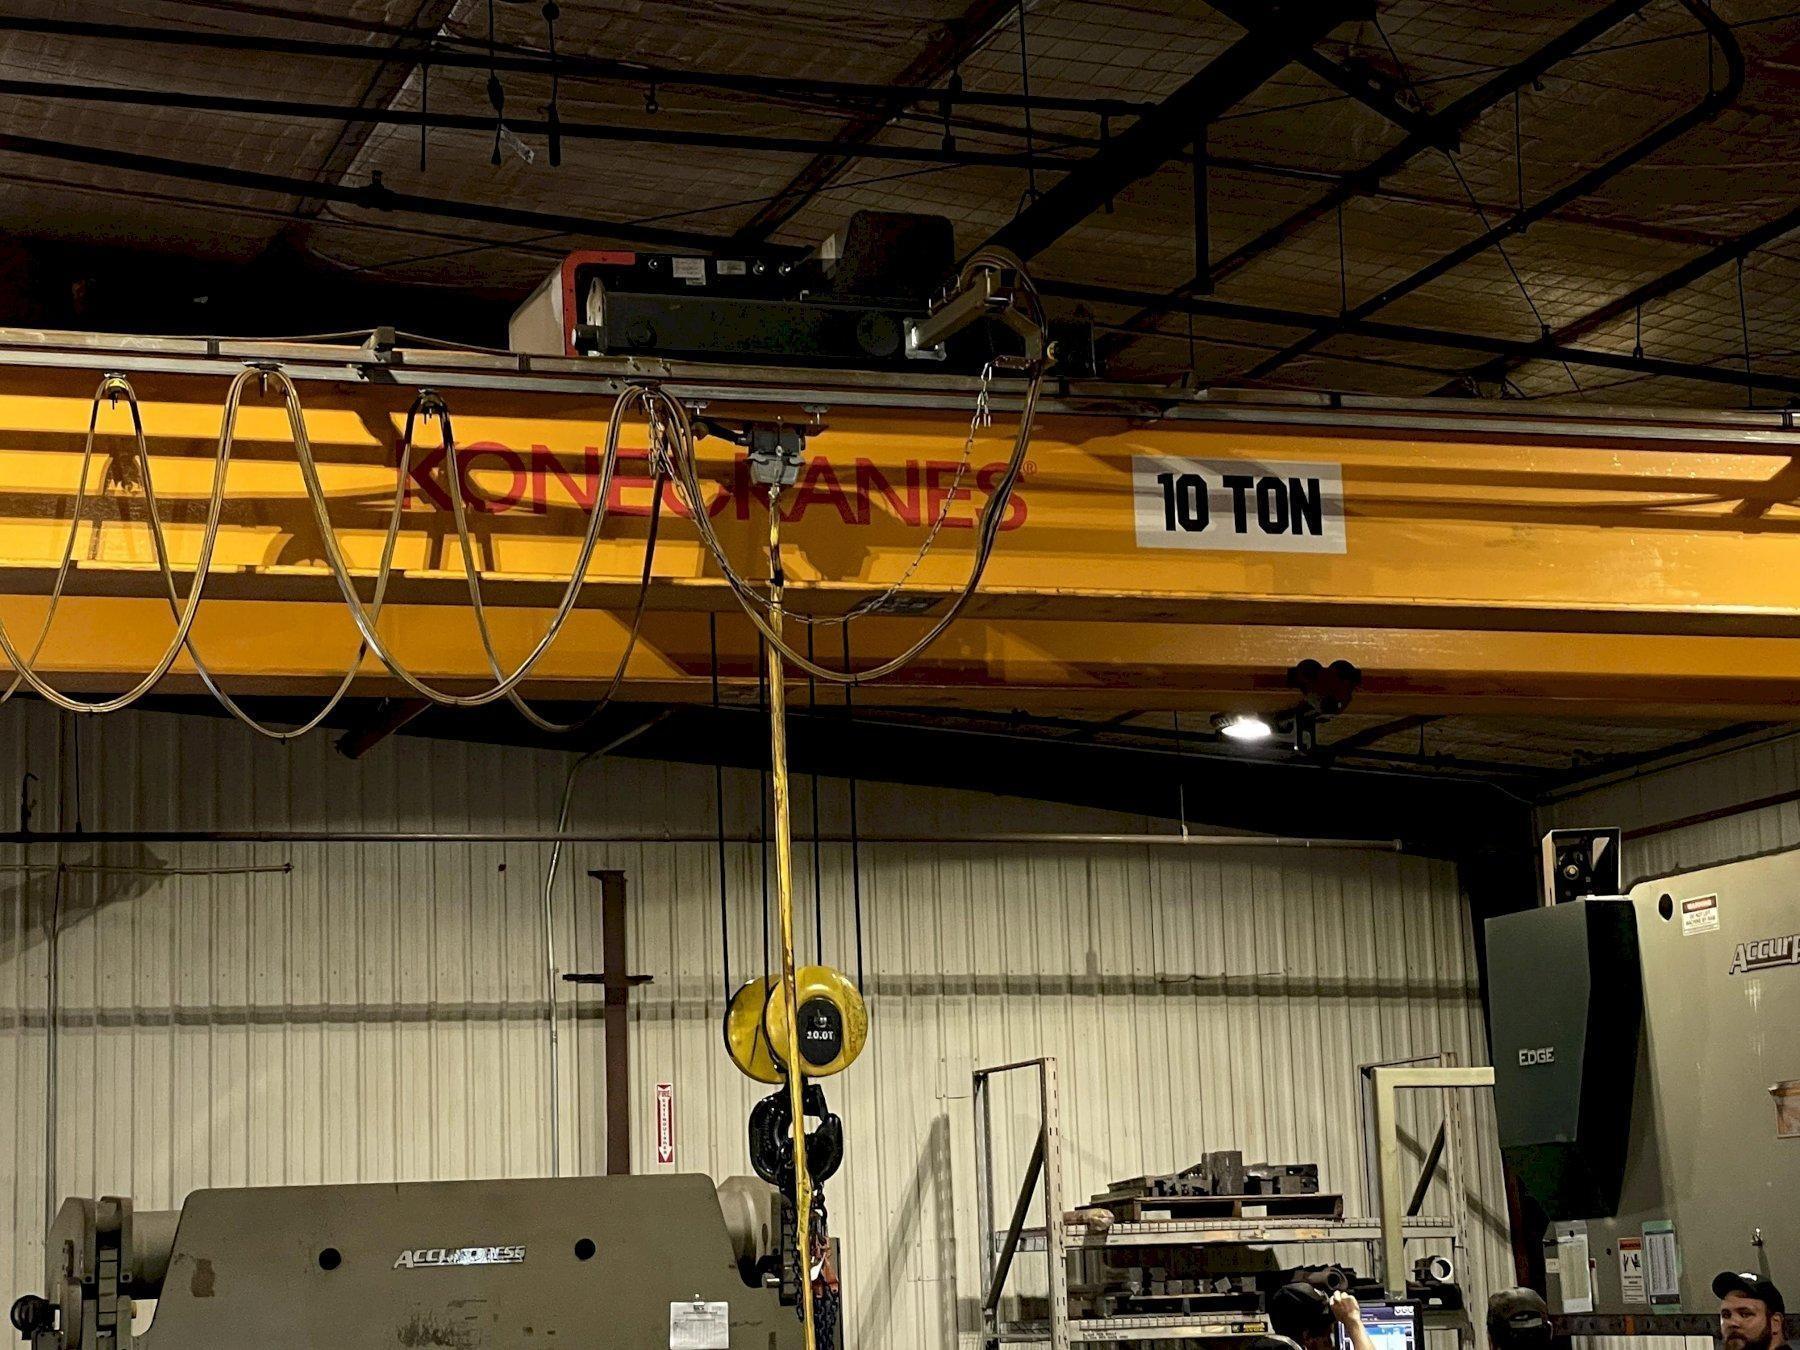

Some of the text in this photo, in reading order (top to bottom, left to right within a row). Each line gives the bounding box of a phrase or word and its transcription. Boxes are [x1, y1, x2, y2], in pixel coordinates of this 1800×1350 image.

[1157, 473, 1323, 535] 10 TON
[1519, 1047, 1555, 1066] EDGE
